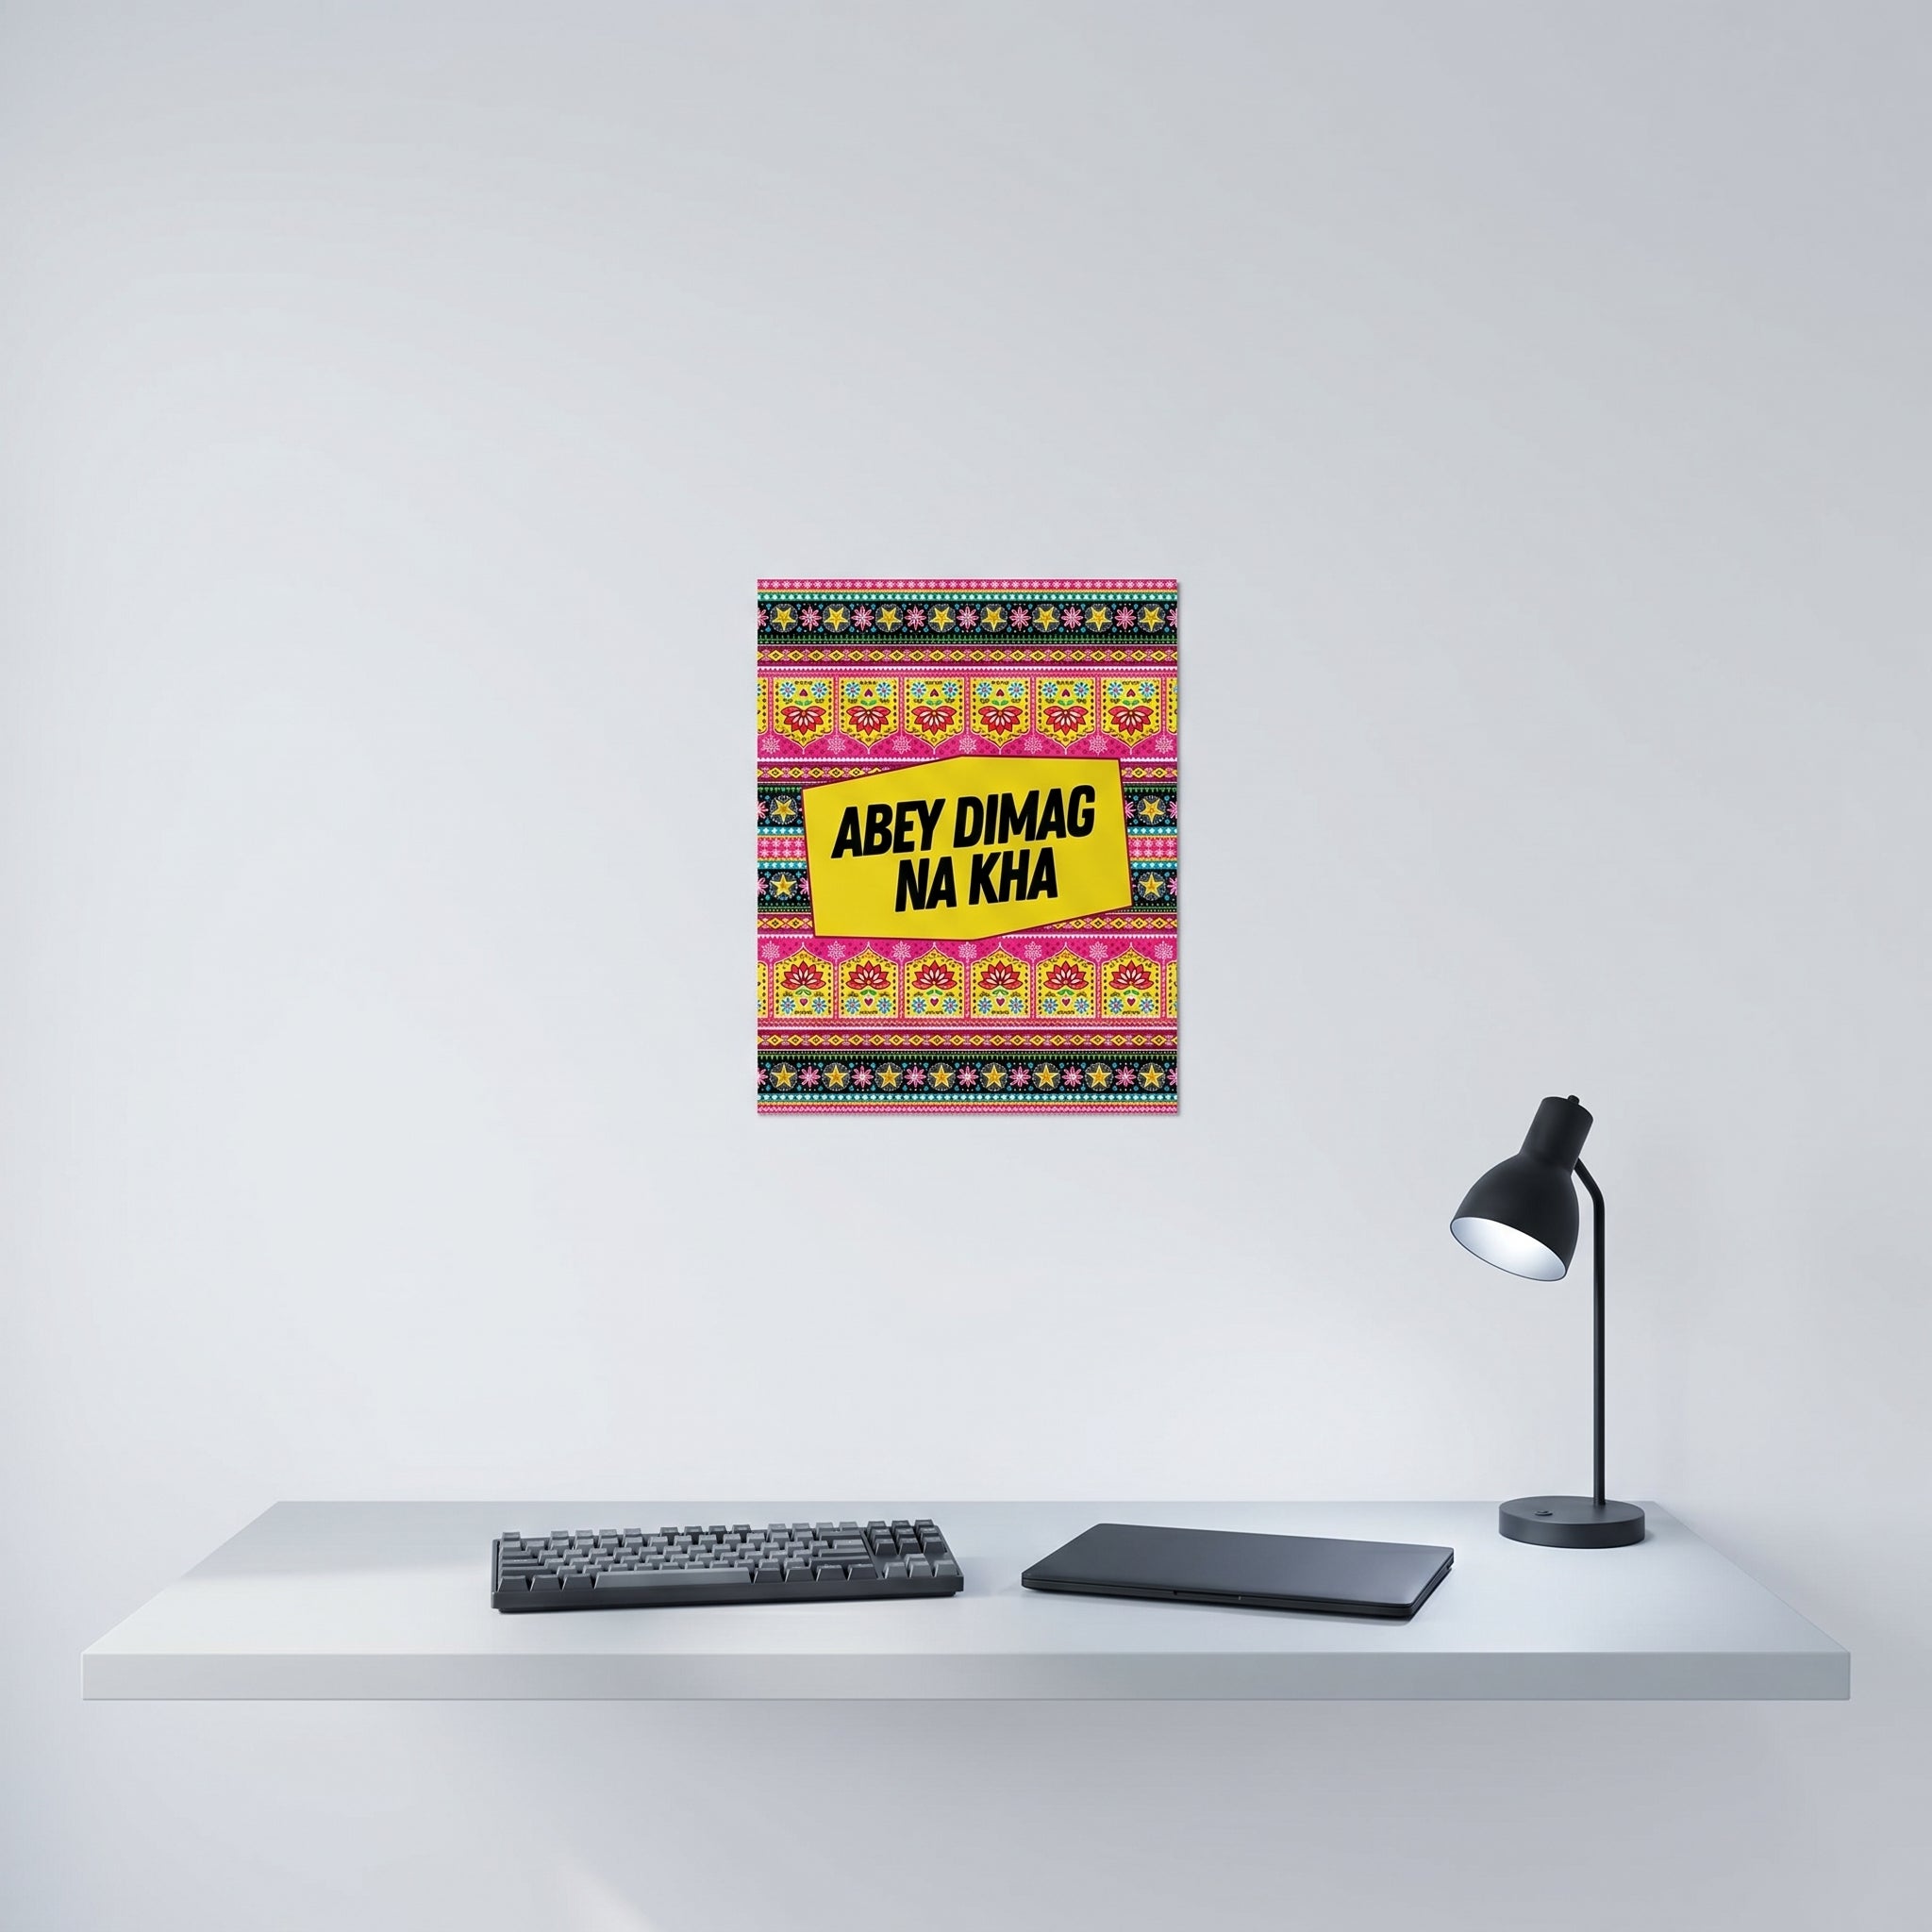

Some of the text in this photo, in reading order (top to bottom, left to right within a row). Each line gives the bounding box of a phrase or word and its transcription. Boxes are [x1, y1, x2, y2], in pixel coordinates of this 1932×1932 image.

[831, 785, 1095, 859] ABEY DIMAG
[895, 847, 1058, 913] NA KHA
